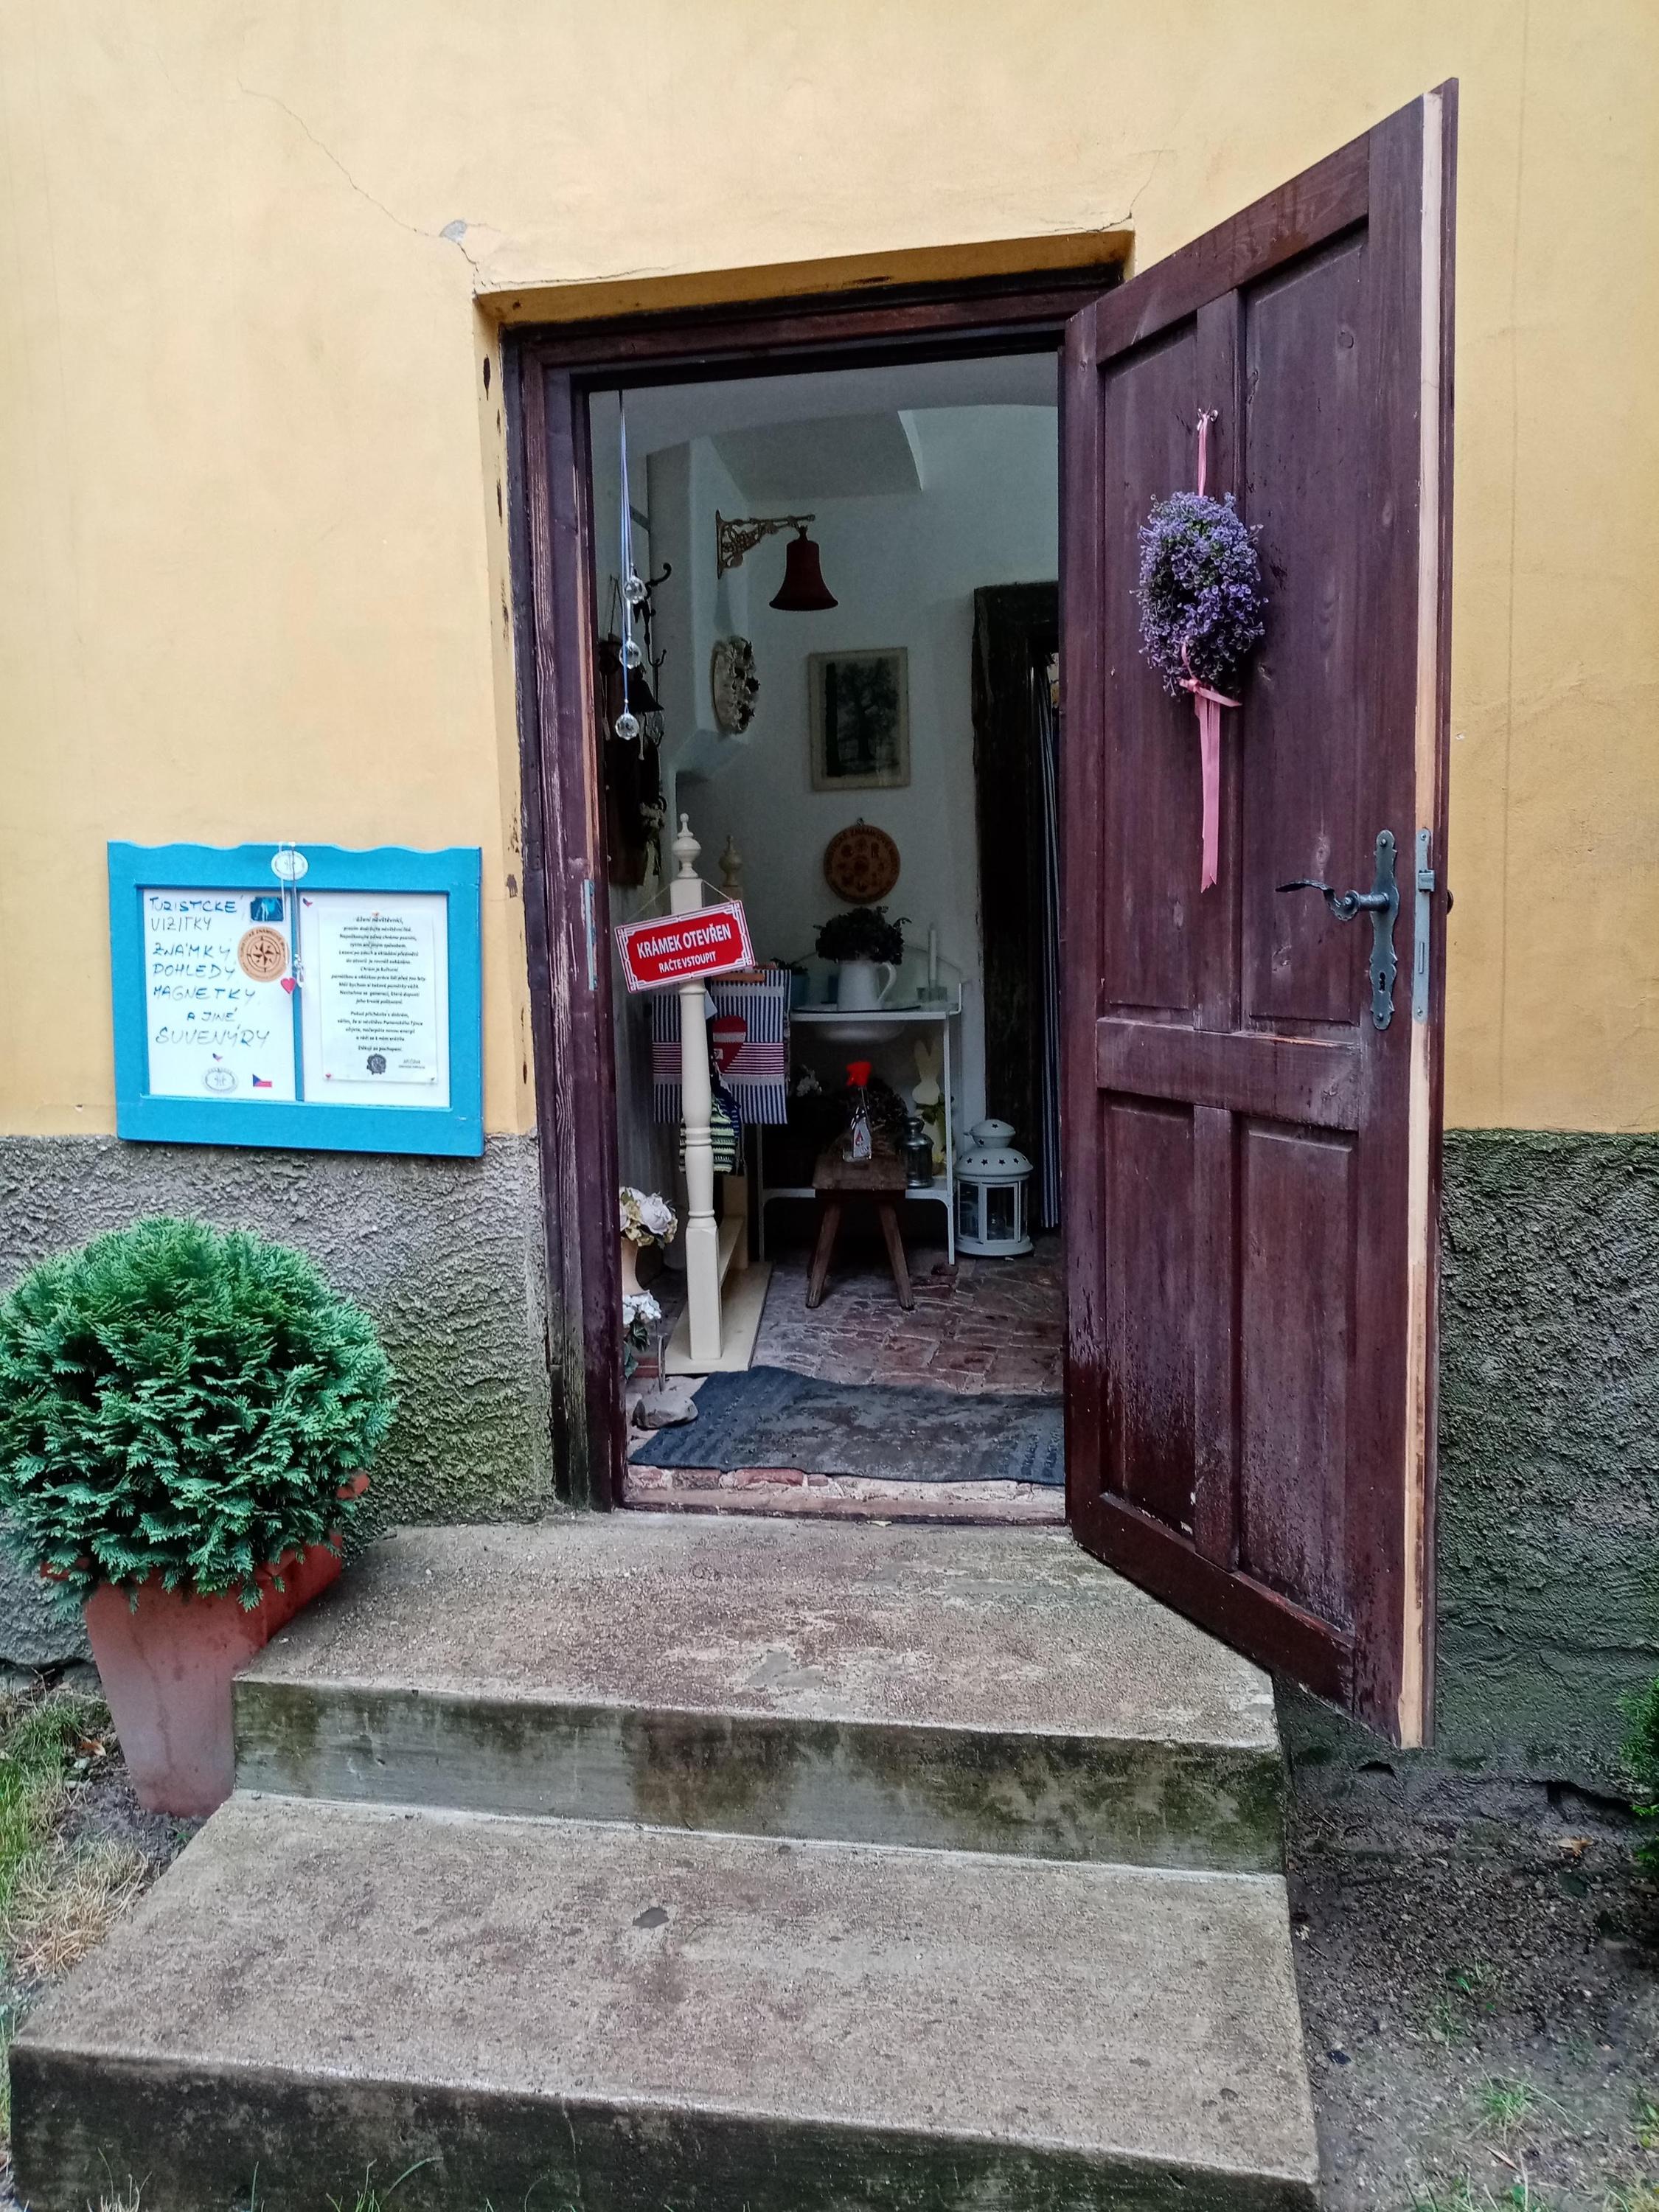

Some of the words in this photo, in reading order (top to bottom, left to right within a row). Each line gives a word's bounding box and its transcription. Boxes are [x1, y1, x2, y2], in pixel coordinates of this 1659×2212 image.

[151, 917, 212, 932] VIZITKY
[637, 936, 683, 959] KRÁMEK
[683, 922, 731, 949] OTEVŘEN
[658, 957, 683, 974] RAČTE
[682, 950, 717, 970] VSTOUPIT
[154, 985, 255, 1006] MAGNETKY
[187, 1012, 195, 1021] A
[201, 1007, 237, 1023] JINÉ
[156, 1024, 270, 1048] SUVENÝRY
